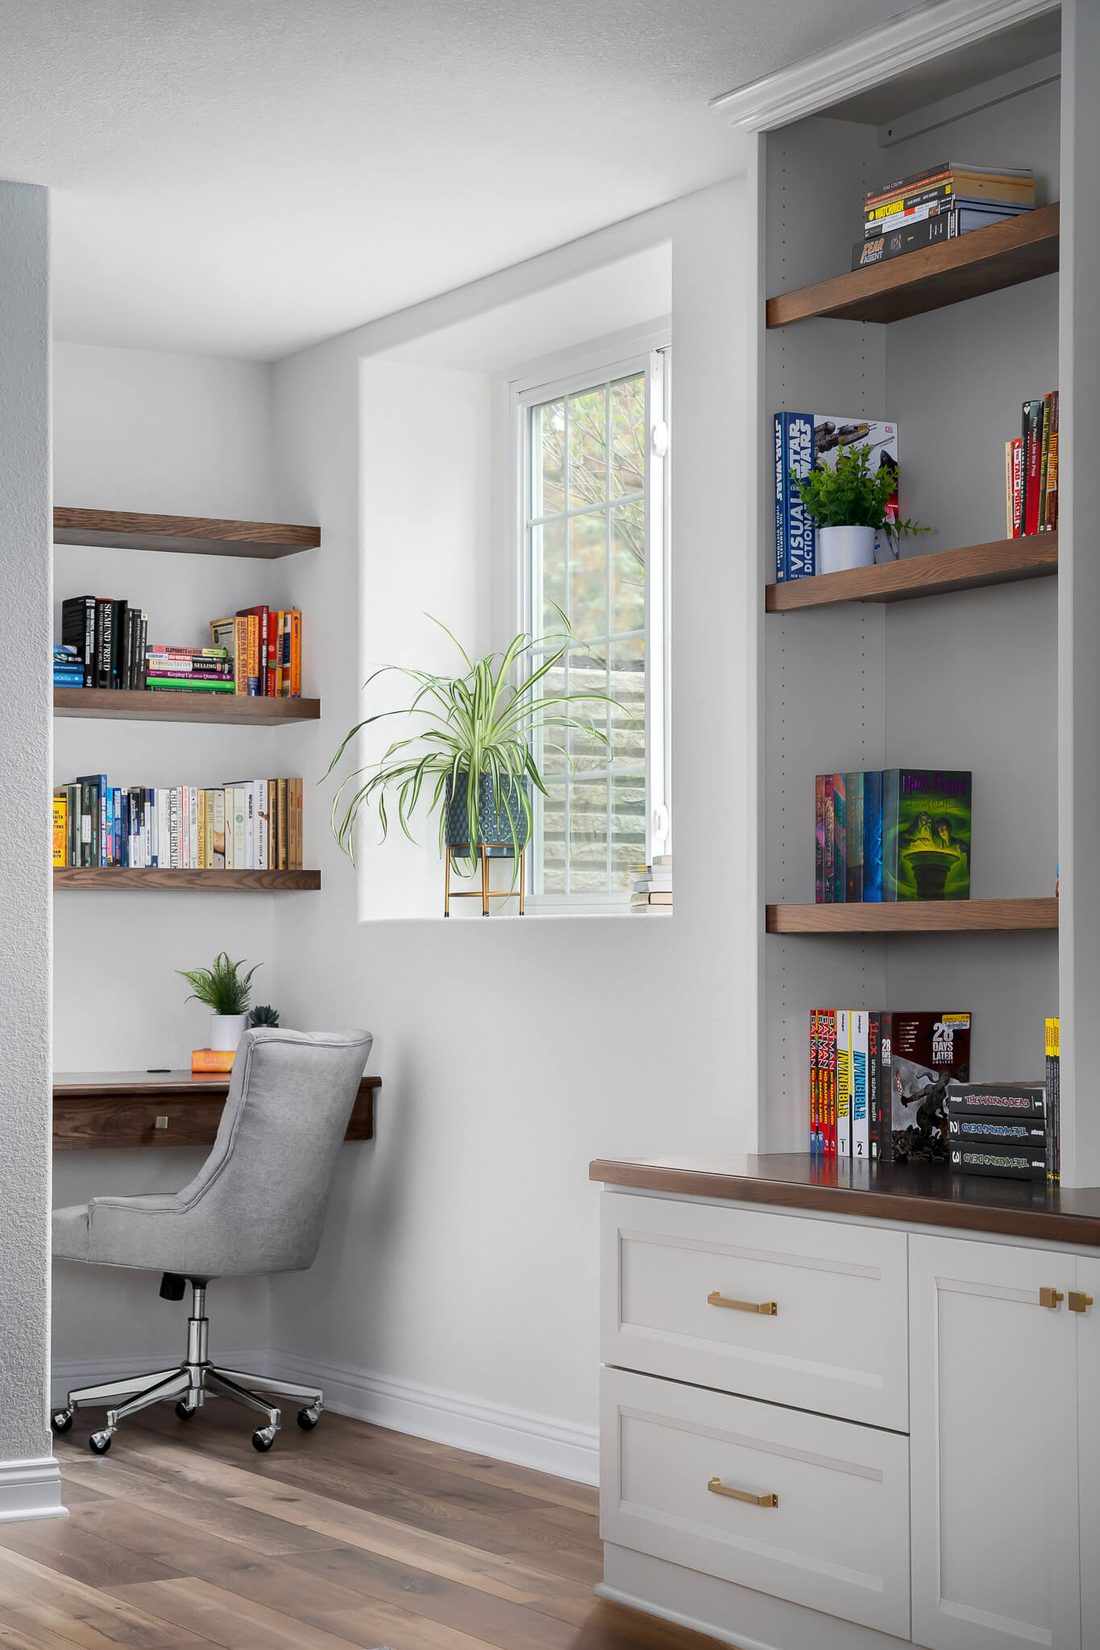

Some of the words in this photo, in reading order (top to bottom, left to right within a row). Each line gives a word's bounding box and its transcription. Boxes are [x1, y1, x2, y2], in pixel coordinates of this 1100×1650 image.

[876, 199, 904, 220] WATCHMEN
[860, 238, 885, 264] FEAR
[864, 250, 884, 264] AGENT
[789, 419, 801, 479] STAR
[800, 420, 812, 478] WARS
[790, 498, 804, 572] VISUAL
[804, 504, 812, 573] DICTIONA
[104, 603, 112, 642] SIGMUND
[868, 1020, 879, 1055] jinx
[933, 1022, 954, 1041] 28
[882, 1039, 891, 1052] 28
[932, 1042, 954, 1052] DAYS
[932, 1052, 953, 1060] LATER
[838, 1049, 848, 1117] INVINCIBLE
[853, 1050, 866, 1121] INVINCIBLE
[964, 1095, 980, 1105] THE
[980, 1095, 1008, 1107] WALKING
[1008, 1097, 1030, 1108] DEAD
[949, 1121, 957, 1133] 2
[962, 1123, 983, 1135] DEAD
[983, 1124, 1012, 1136] WALKING
[1012, 1126, 1029, 1138] THE
[841, 1141, 844, 1152] 1
[857, 1143, 862, 1155] 2
[952, 1151, 960, 1163] 3
[963, 1153, 984, 1164] DEAD
[984, 1154, 1013, 1167] WALKING
[1013, 1157, 1030, 1168] THE
